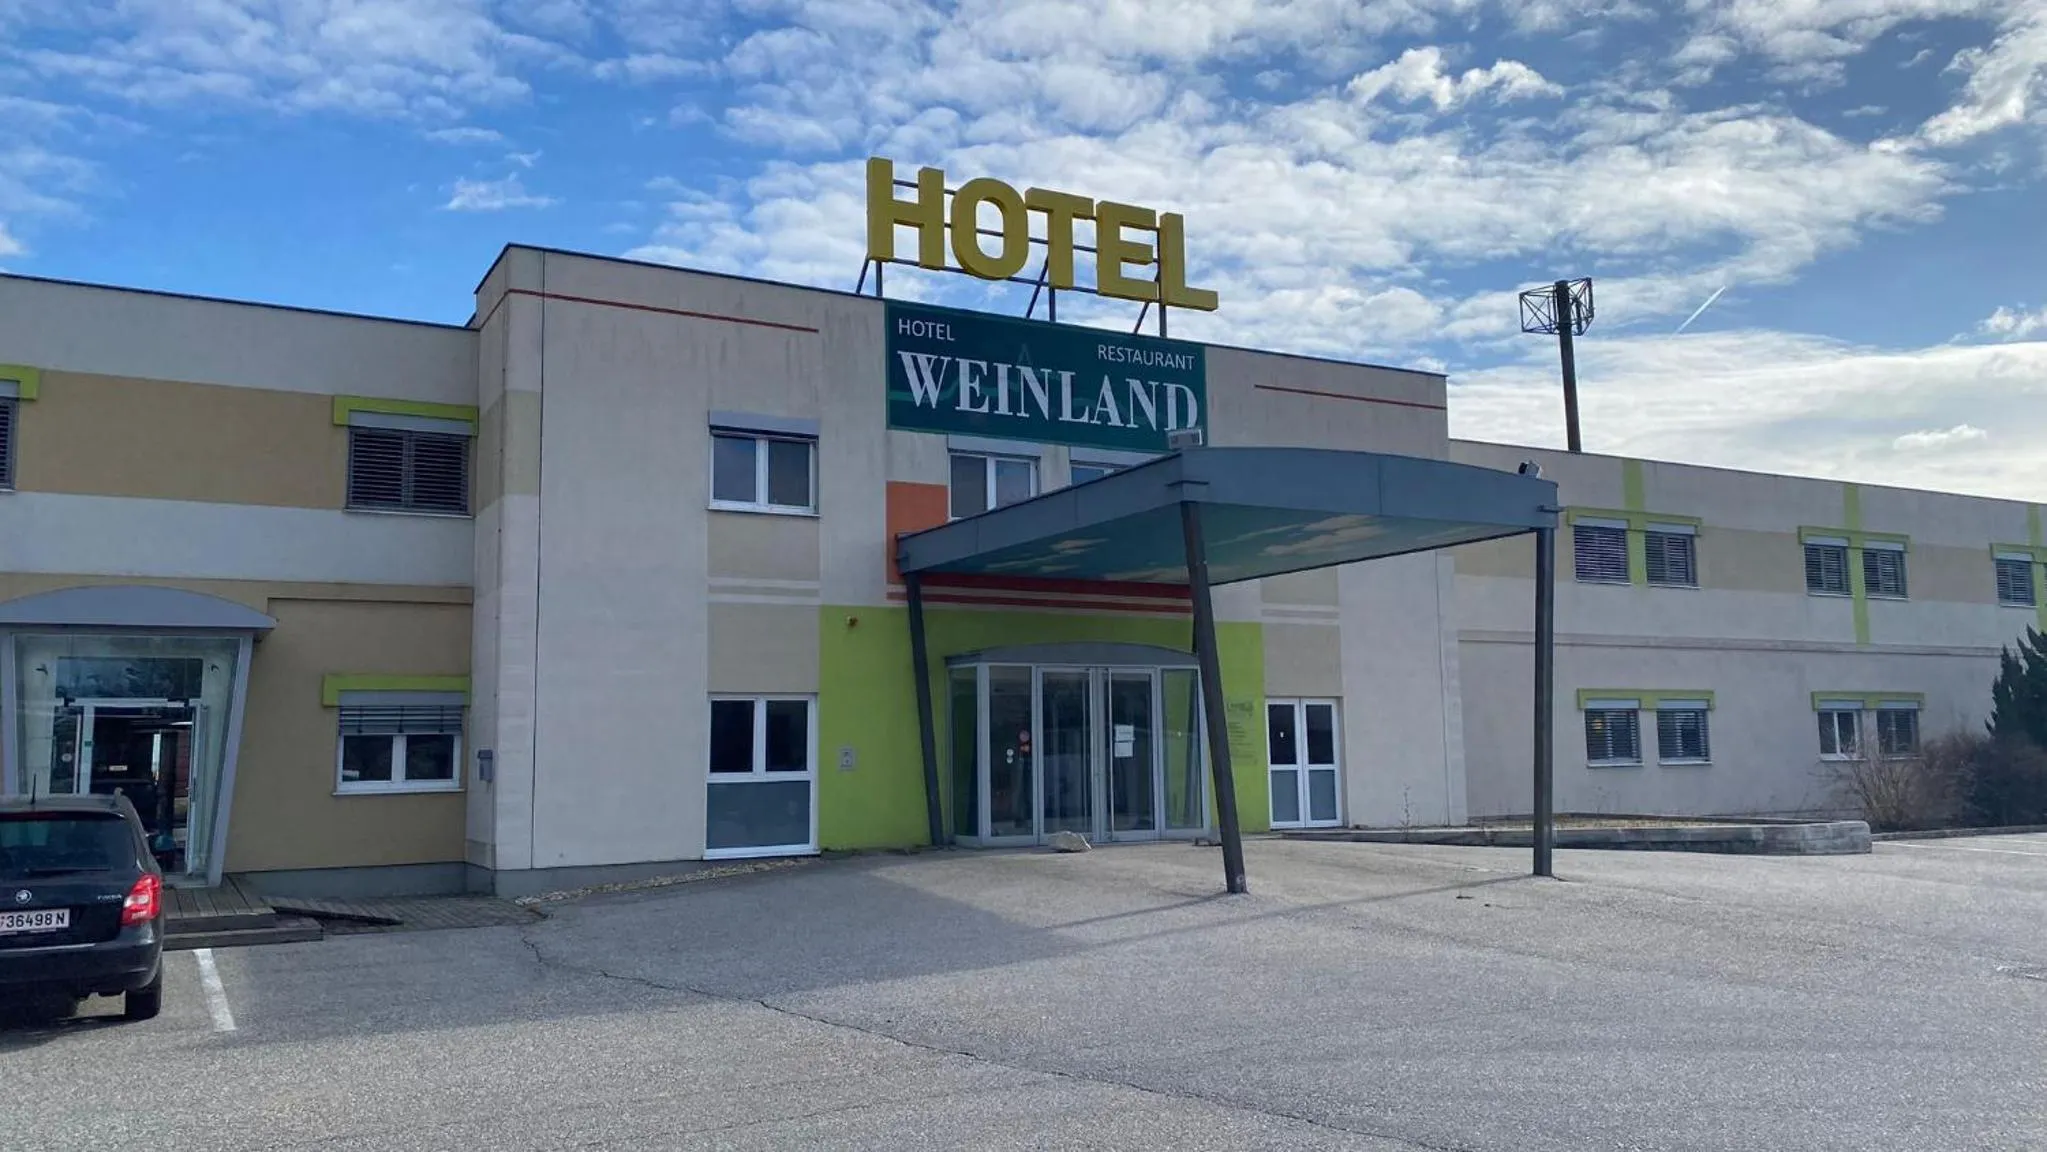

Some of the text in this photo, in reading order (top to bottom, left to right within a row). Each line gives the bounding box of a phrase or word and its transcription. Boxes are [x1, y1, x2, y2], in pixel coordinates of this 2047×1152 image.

[867, 157, 1218, 311] HOTEL
[898, 318, 1195, 370] HOTEL RESTAURANT
[897, 350, 1198, 431] WEINLAND
